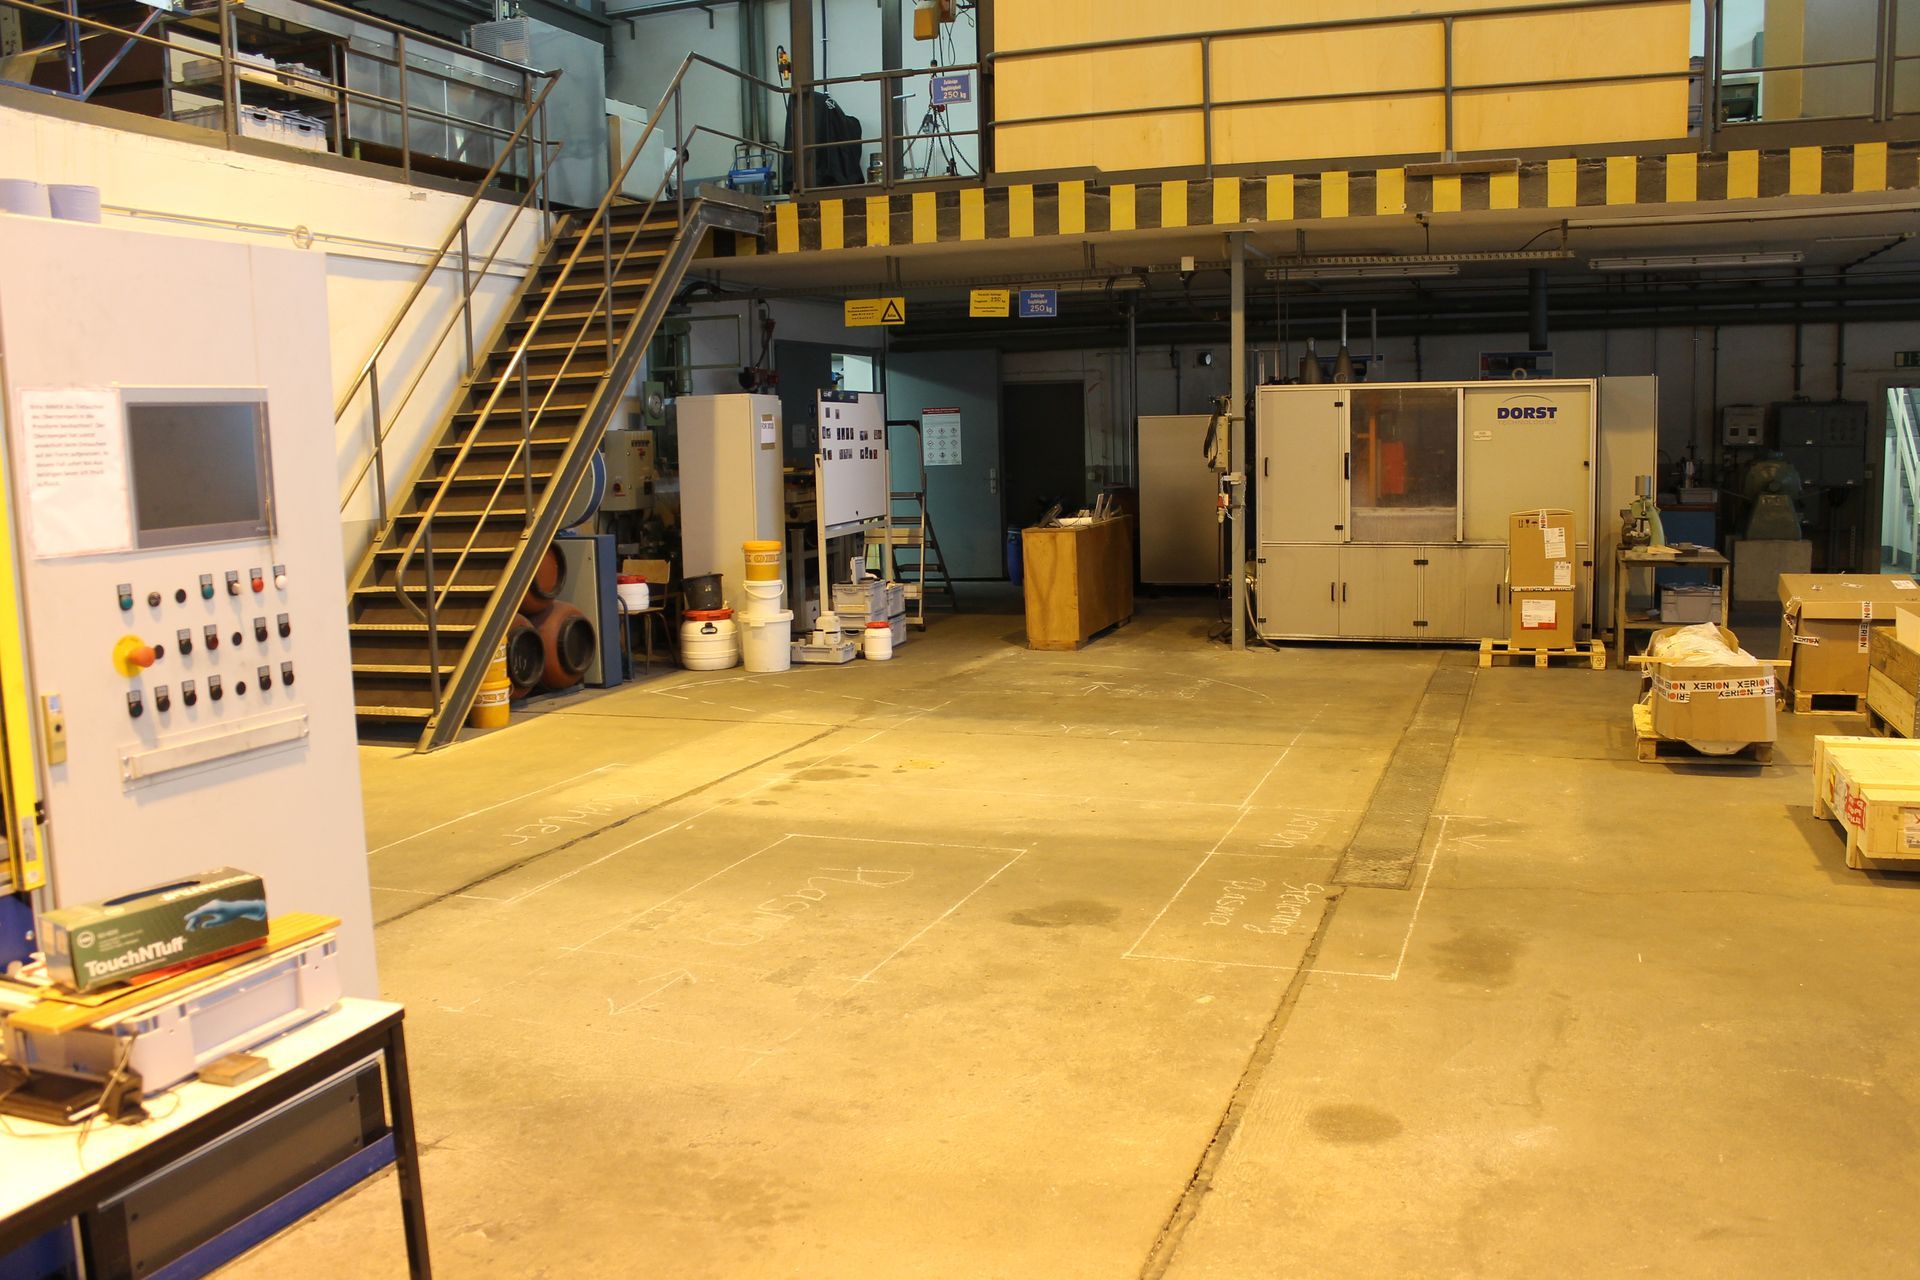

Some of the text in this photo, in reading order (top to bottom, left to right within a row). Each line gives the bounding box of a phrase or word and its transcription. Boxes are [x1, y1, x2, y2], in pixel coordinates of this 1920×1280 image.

[943, 91, 959, 99] 250
[1030, 304, 1045, 313] 250
[1497, 407, 1558, 419] DORST
[1693, 682, 1729, 690] XERION
[1737, 678, 1769, 688] XERION
[1243, 883, 1324, 935] Steuerung
[84, 935, 184, 977] TouchNTuff
